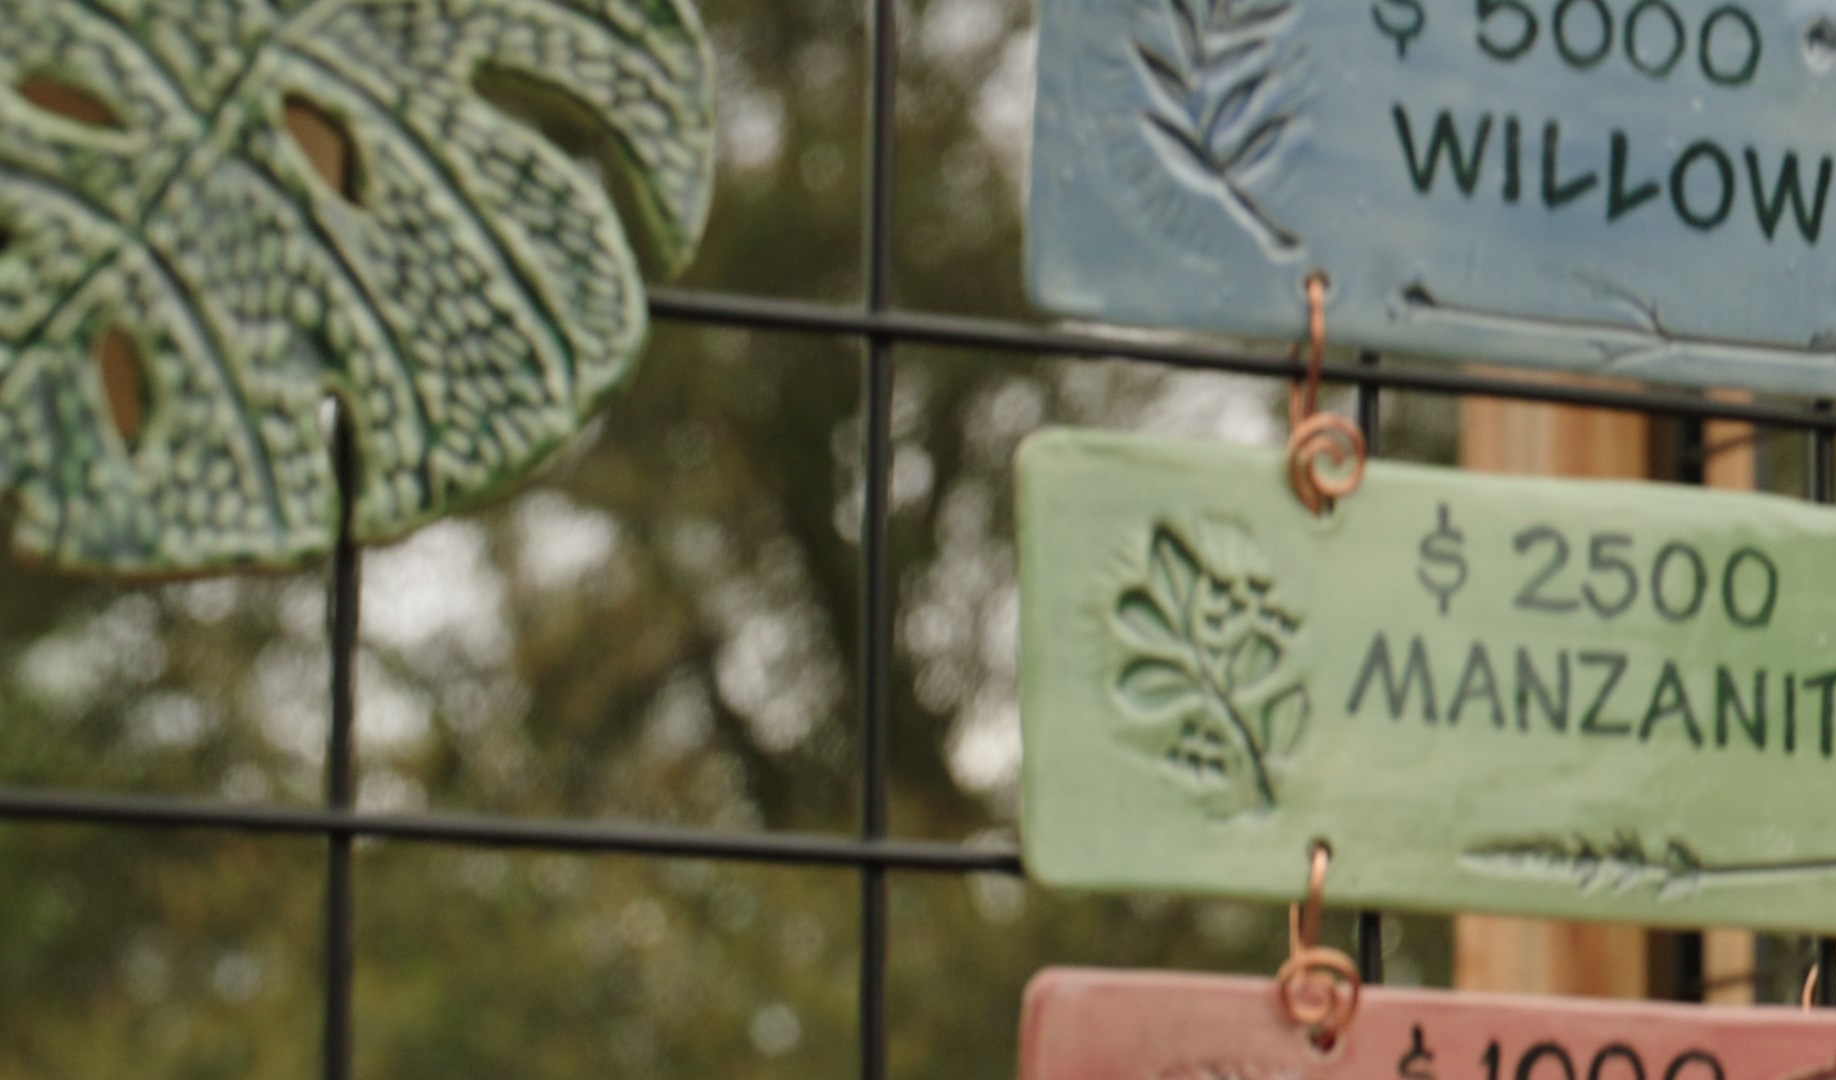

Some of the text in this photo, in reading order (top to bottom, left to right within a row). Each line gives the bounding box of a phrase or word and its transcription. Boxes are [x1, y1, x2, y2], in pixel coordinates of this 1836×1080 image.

[1475, 0, 1763, 86] 5000
[1392, 102, 1834, 245] WILLOW
[1417, 501, 1779, 628] $ 2500
